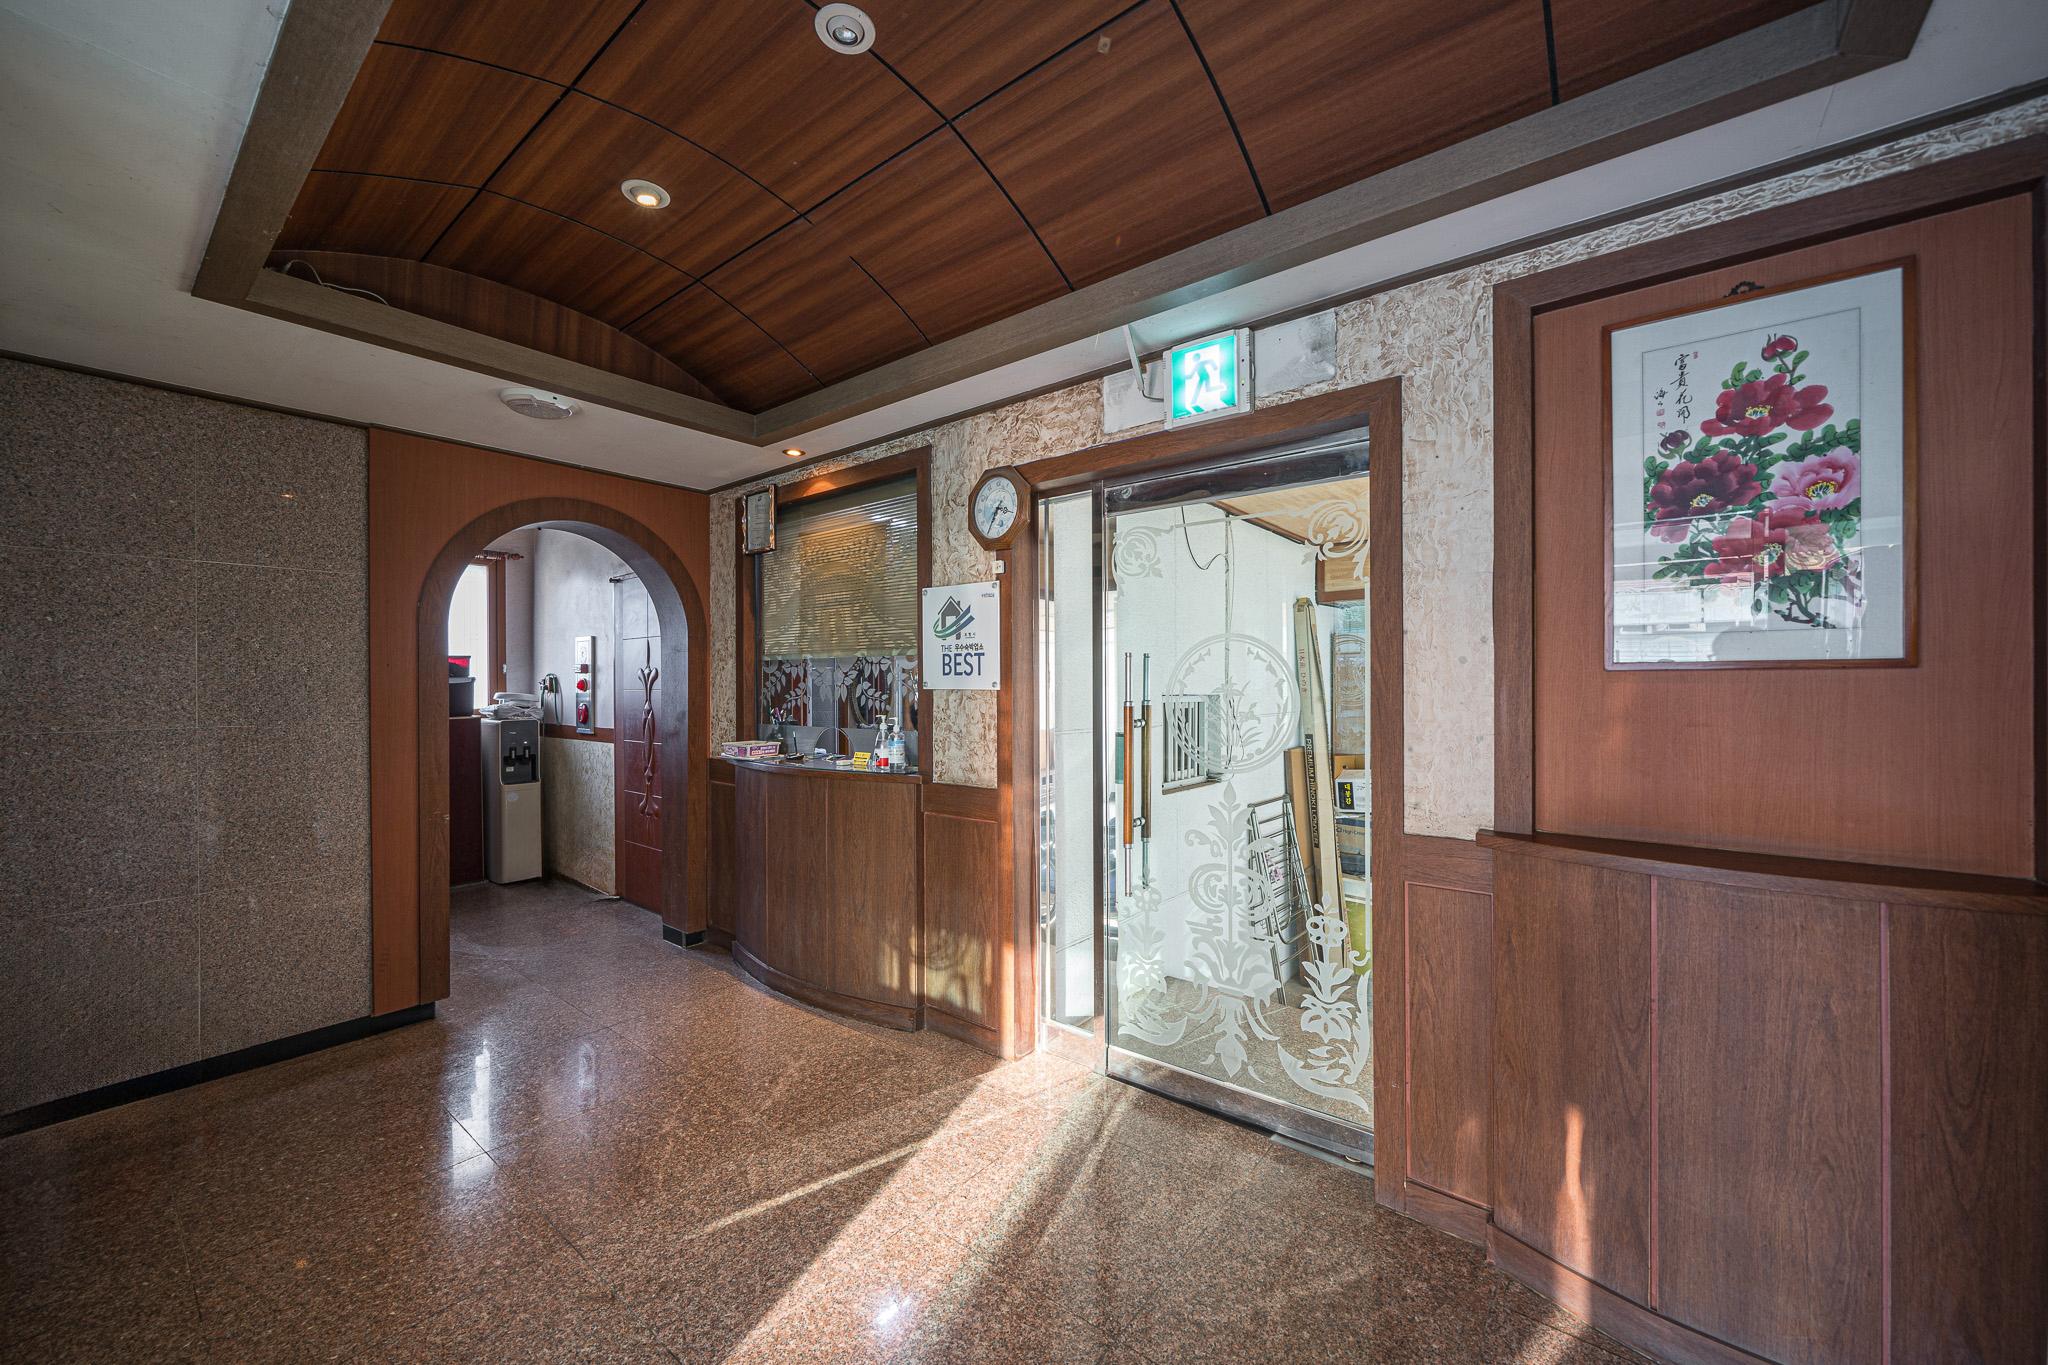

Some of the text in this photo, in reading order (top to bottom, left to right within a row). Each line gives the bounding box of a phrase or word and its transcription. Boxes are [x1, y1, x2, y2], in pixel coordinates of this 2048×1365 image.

[941, 645, 953, 653] THE
[942, 653, 985, 676] BEST
[1306, 738, 1314, 777] PREMIUM
